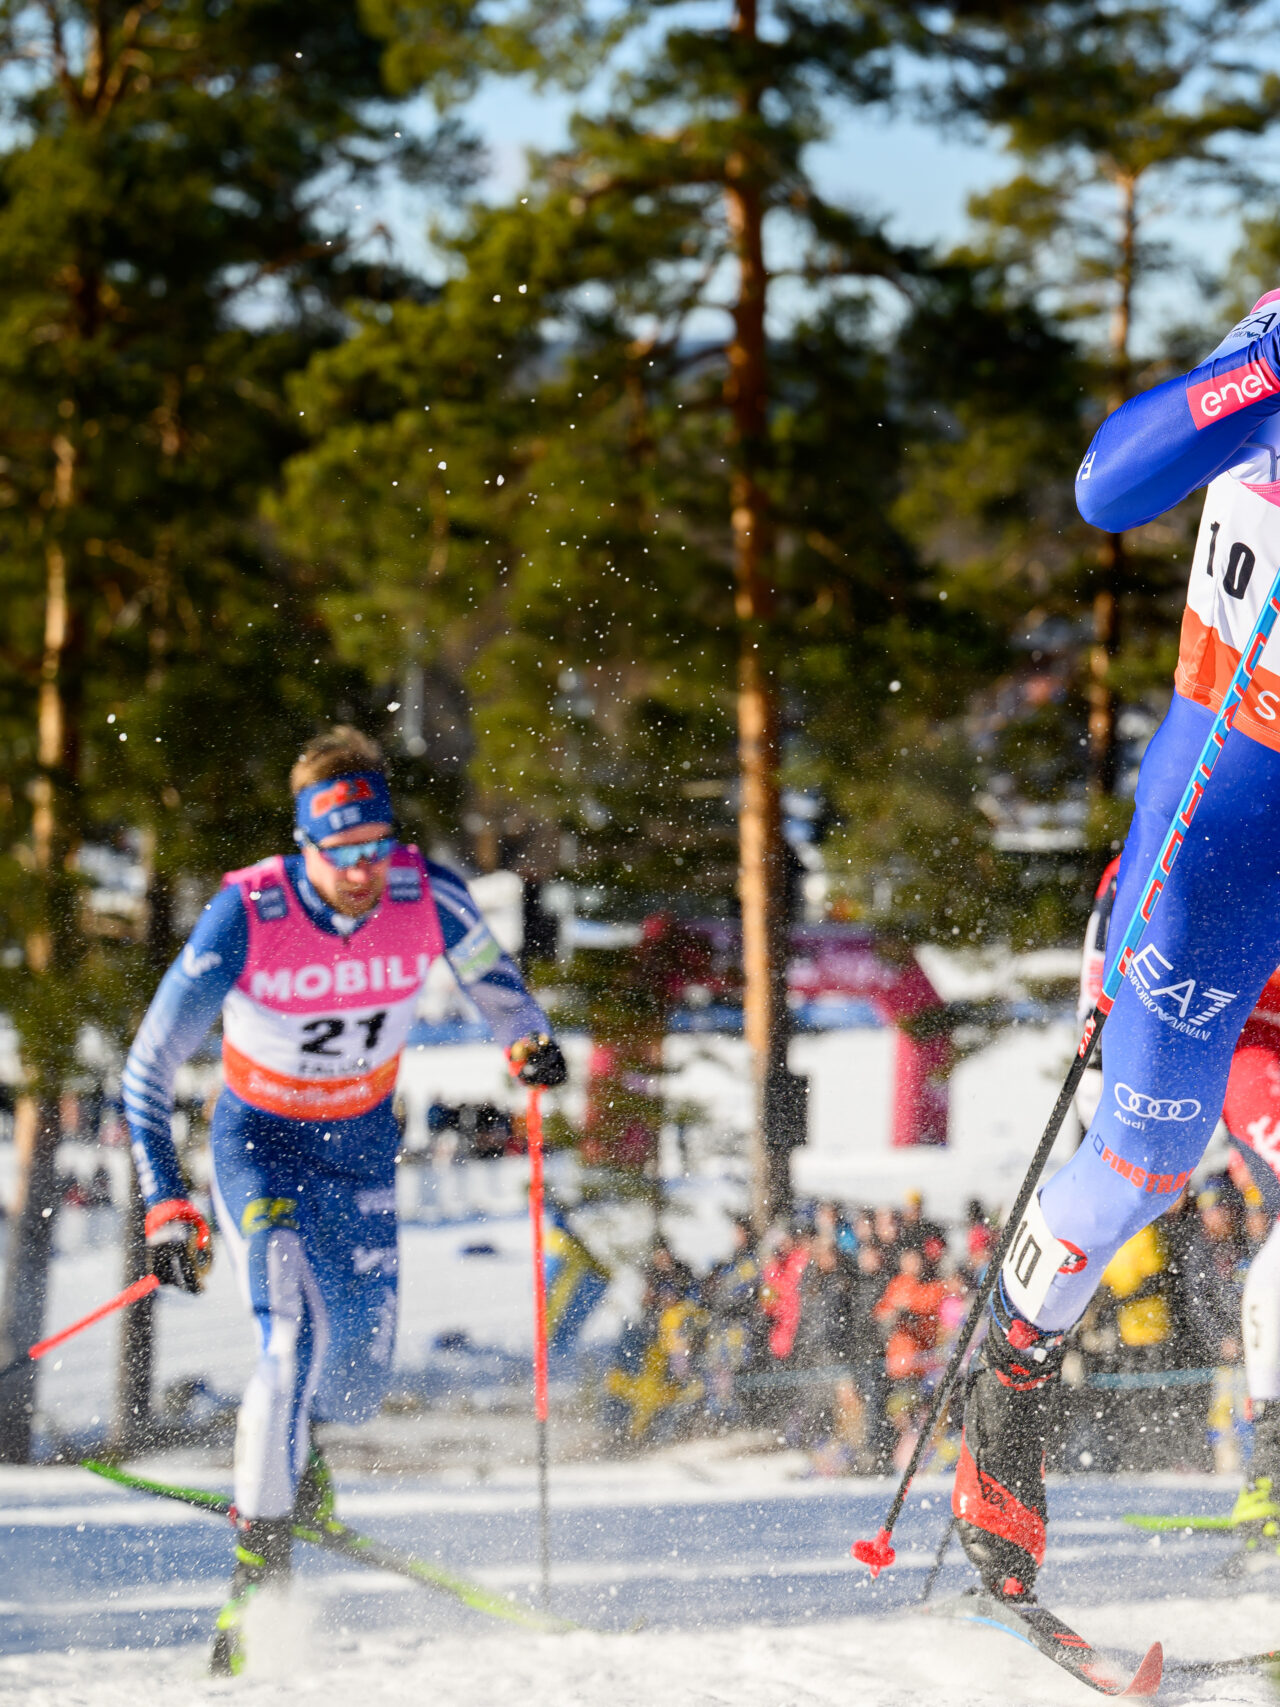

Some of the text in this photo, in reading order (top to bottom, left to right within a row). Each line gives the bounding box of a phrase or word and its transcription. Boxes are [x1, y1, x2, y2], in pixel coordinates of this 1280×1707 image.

[1200, 363, 1273, 417] enel
[1206, 520, 1256, 600] 10
[1132, 943, 1238, 1027] EA7
[301, 1010, 388, 1058] 21
[1168, 1018, 1212, 1041] ARMANI
[1113, 1110, 1146, 1131] Audi
[1008, 1220, 1042, 1290] 10
